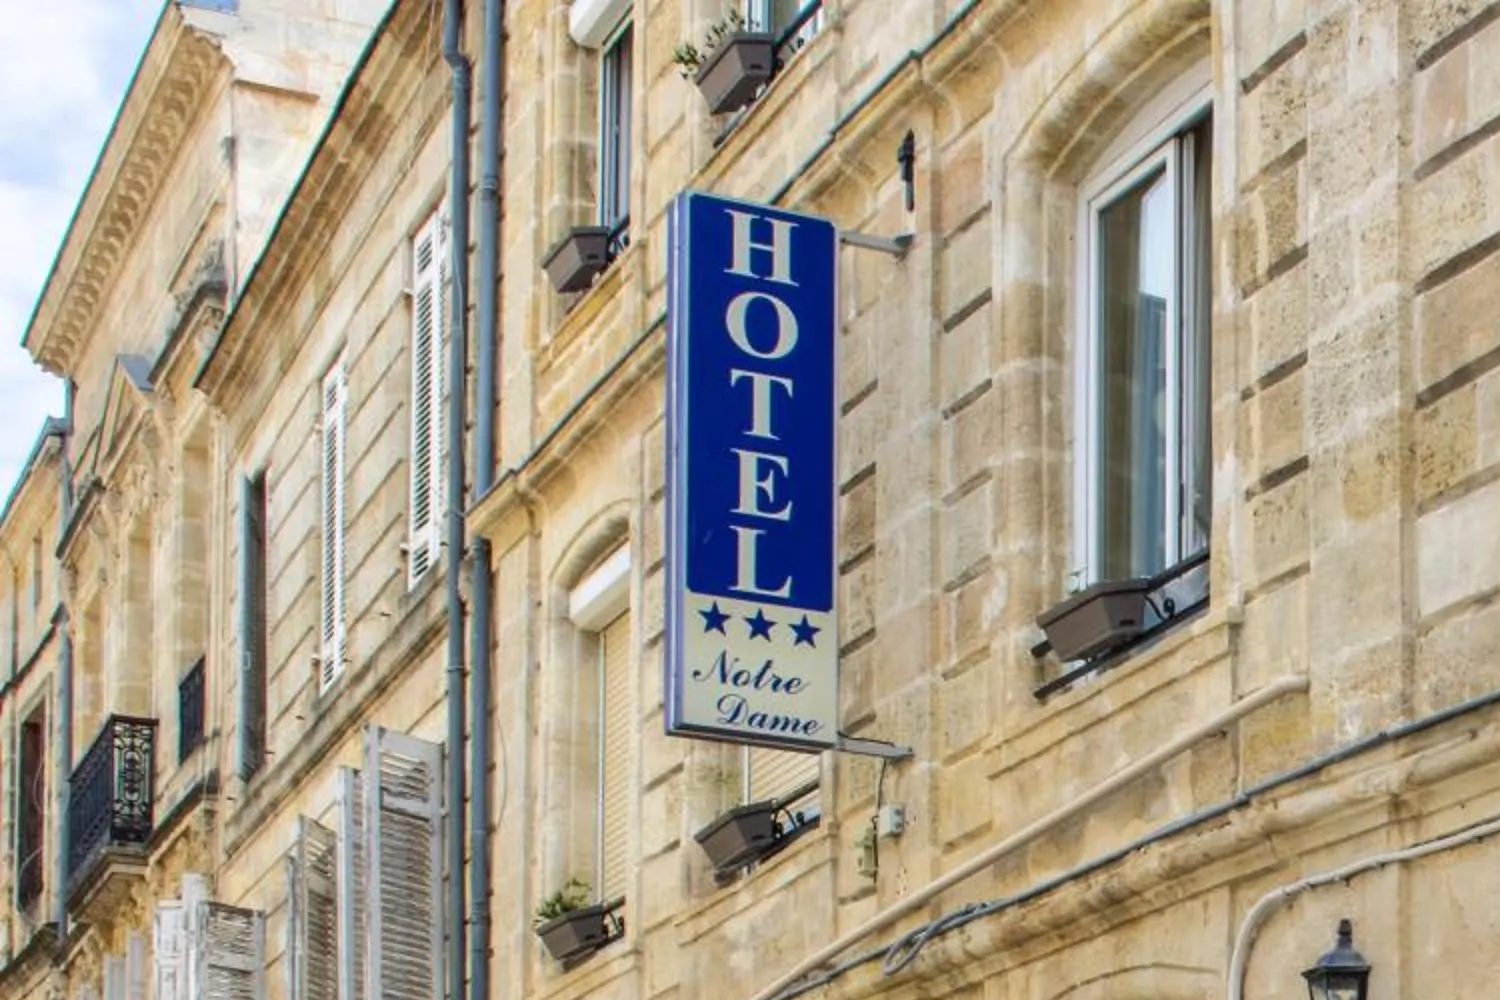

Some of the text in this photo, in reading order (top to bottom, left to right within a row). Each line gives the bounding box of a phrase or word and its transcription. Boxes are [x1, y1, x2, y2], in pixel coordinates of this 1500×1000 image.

[723, 208, 800, 599] HOTEL
[692, 649, 810, 695] Notre
[716, 693, 825, 737] Dame
